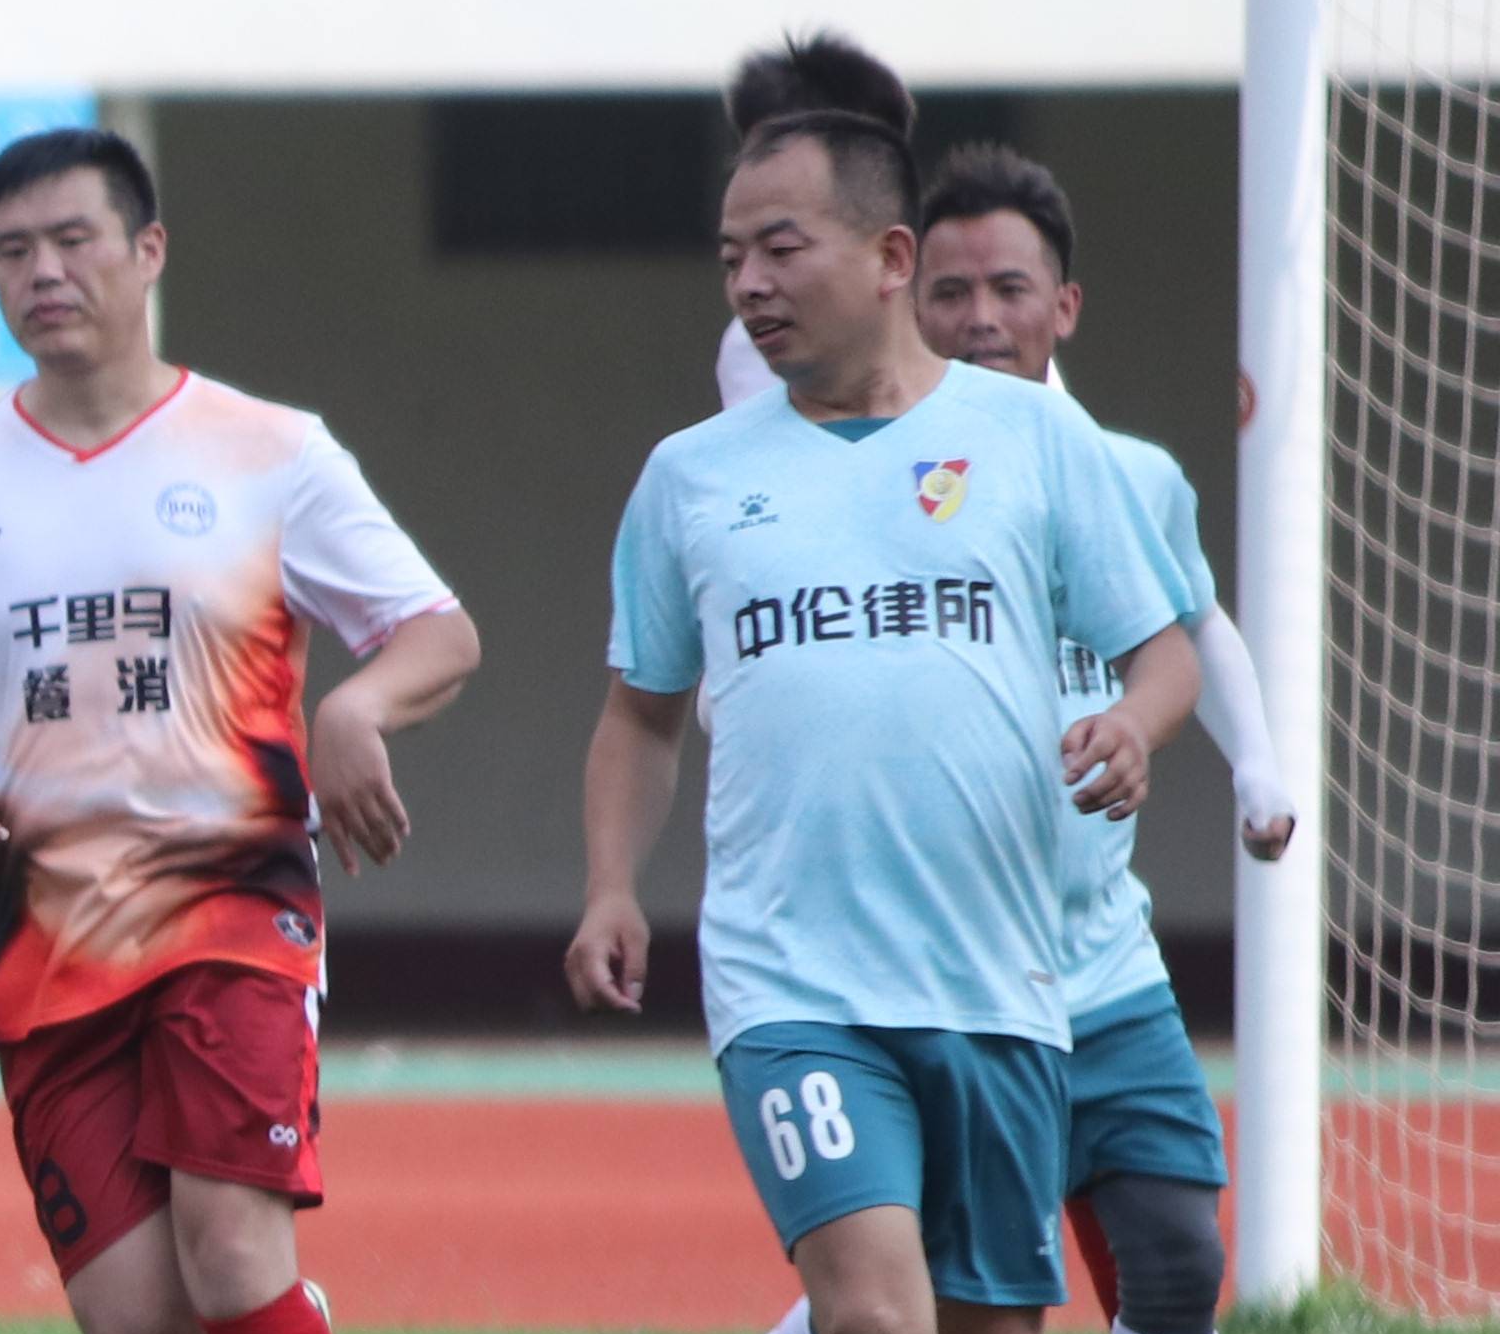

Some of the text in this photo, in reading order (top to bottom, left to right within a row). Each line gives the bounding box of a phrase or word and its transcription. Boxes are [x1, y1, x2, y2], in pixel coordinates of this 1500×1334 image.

[10, 587, 171, 648] 千里马
[734, 579, 994, 659] 中伦律所
[760, 1070, 855, 1181] 68
[35, 1157, 87, 1247] 8
